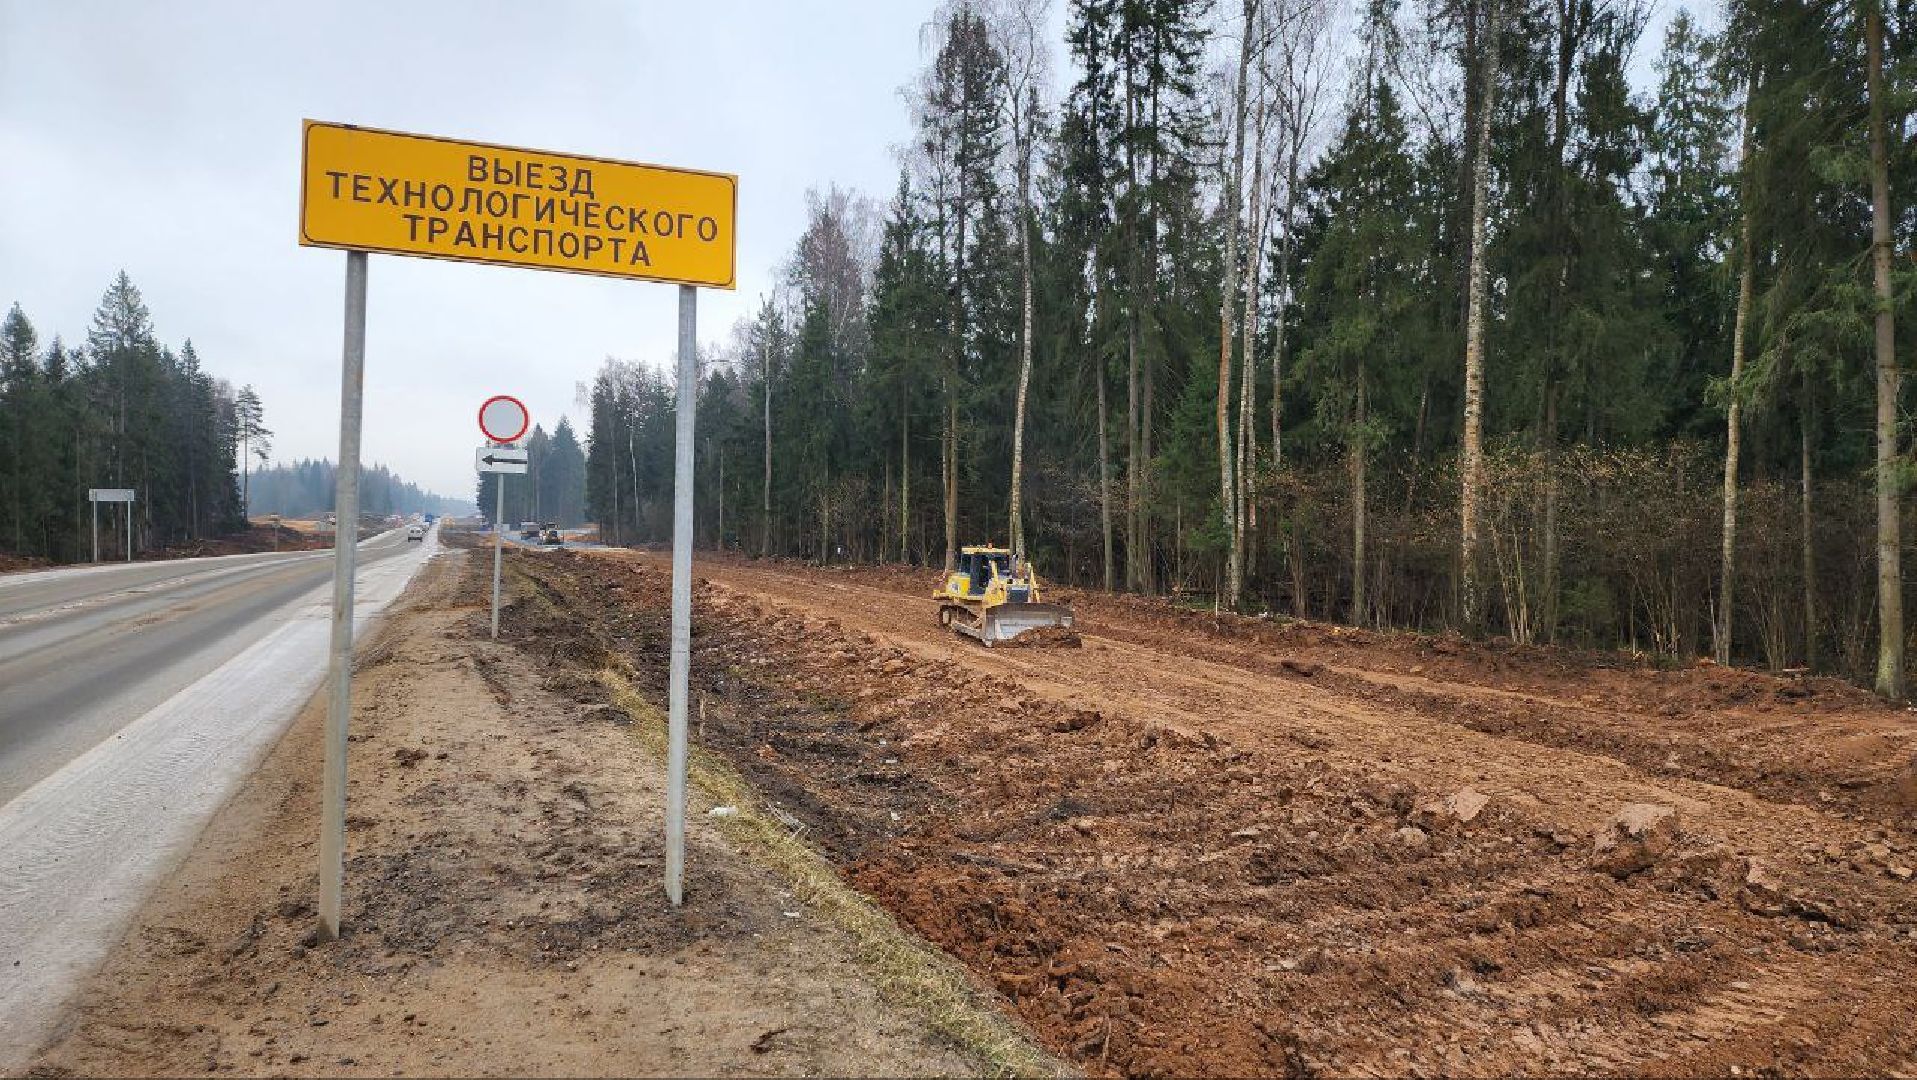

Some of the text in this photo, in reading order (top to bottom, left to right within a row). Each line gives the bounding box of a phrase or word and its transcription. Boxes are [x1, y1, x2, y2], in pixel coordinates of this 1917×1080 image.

[468, 154, 595, 200] ВЫЕЗД
[326, 171, 718, 242] ТЕХНОЛОГИЧЕСКОГО
[403, 214, 651, 267] ТРАНСПОРТА
